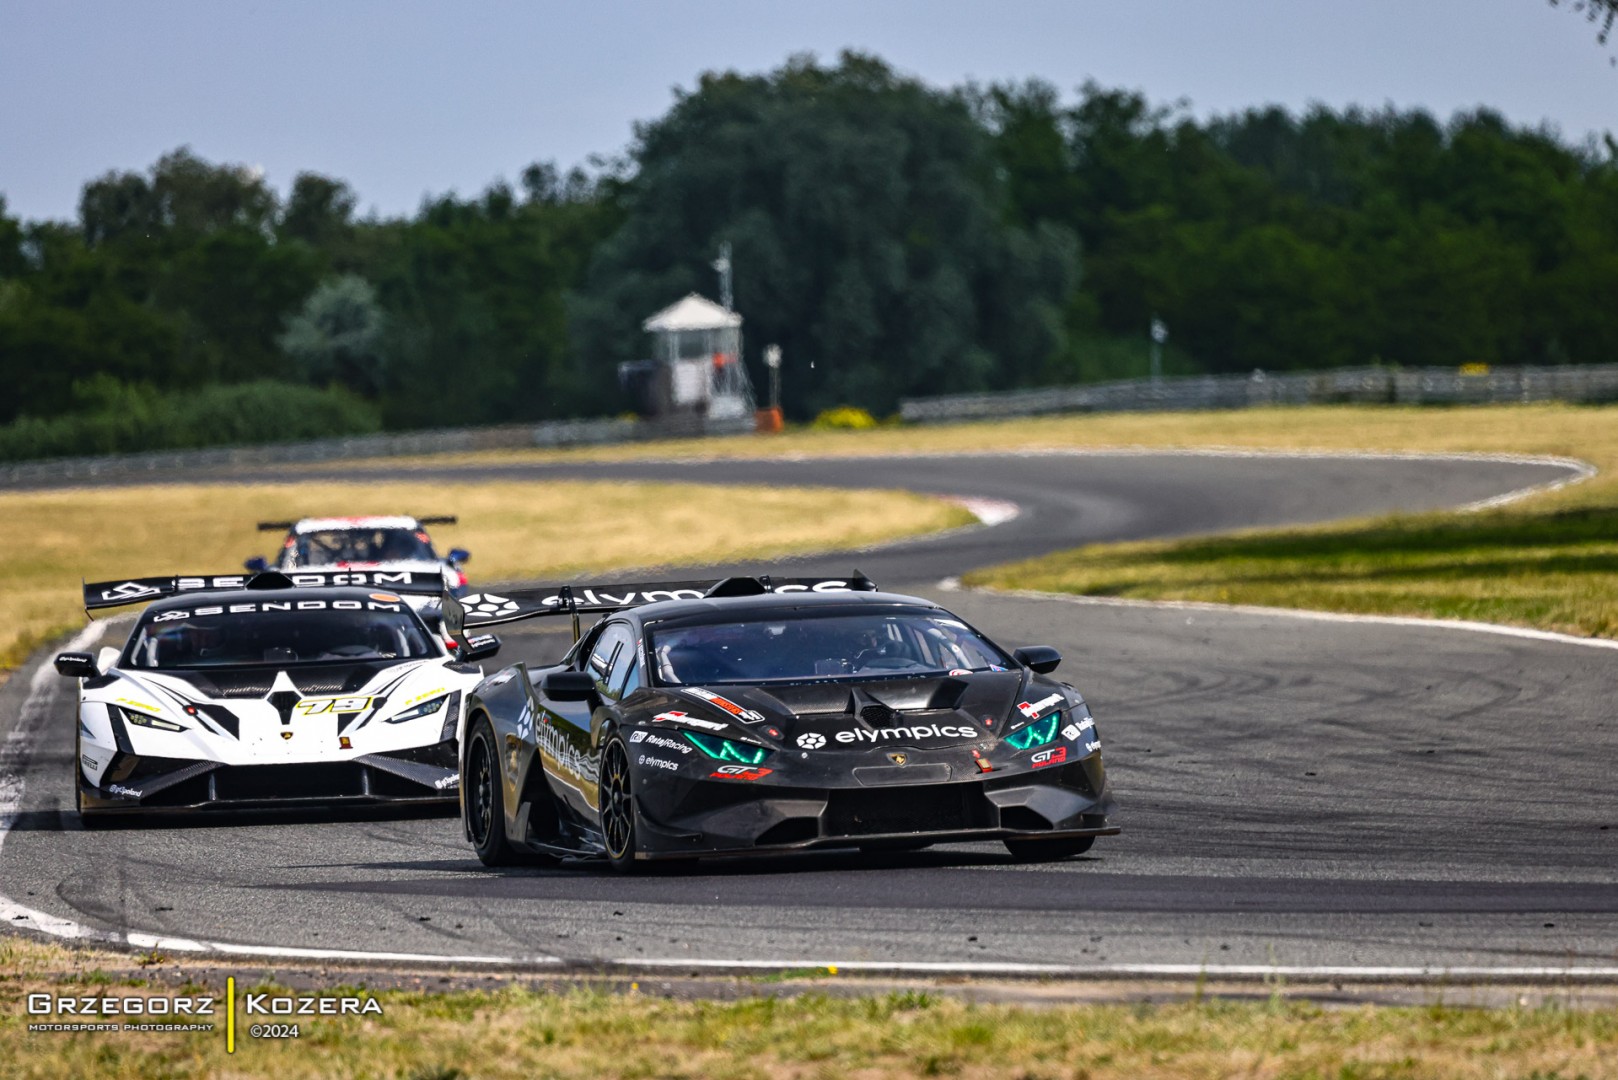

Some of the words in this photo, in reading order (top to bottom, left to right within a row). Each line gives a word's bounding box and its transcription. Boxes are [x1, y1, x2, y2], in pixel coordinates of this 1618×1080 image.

[172, 572, 412, 590] SEDOM
[194, 600, 400, 617] SENDOM
[296, 696, 374, 716] 79
[834, 724, 978, 743] elympics
[645, 734, 693, 754] RatajRacing
[645, 756, 679, 771] elympics
